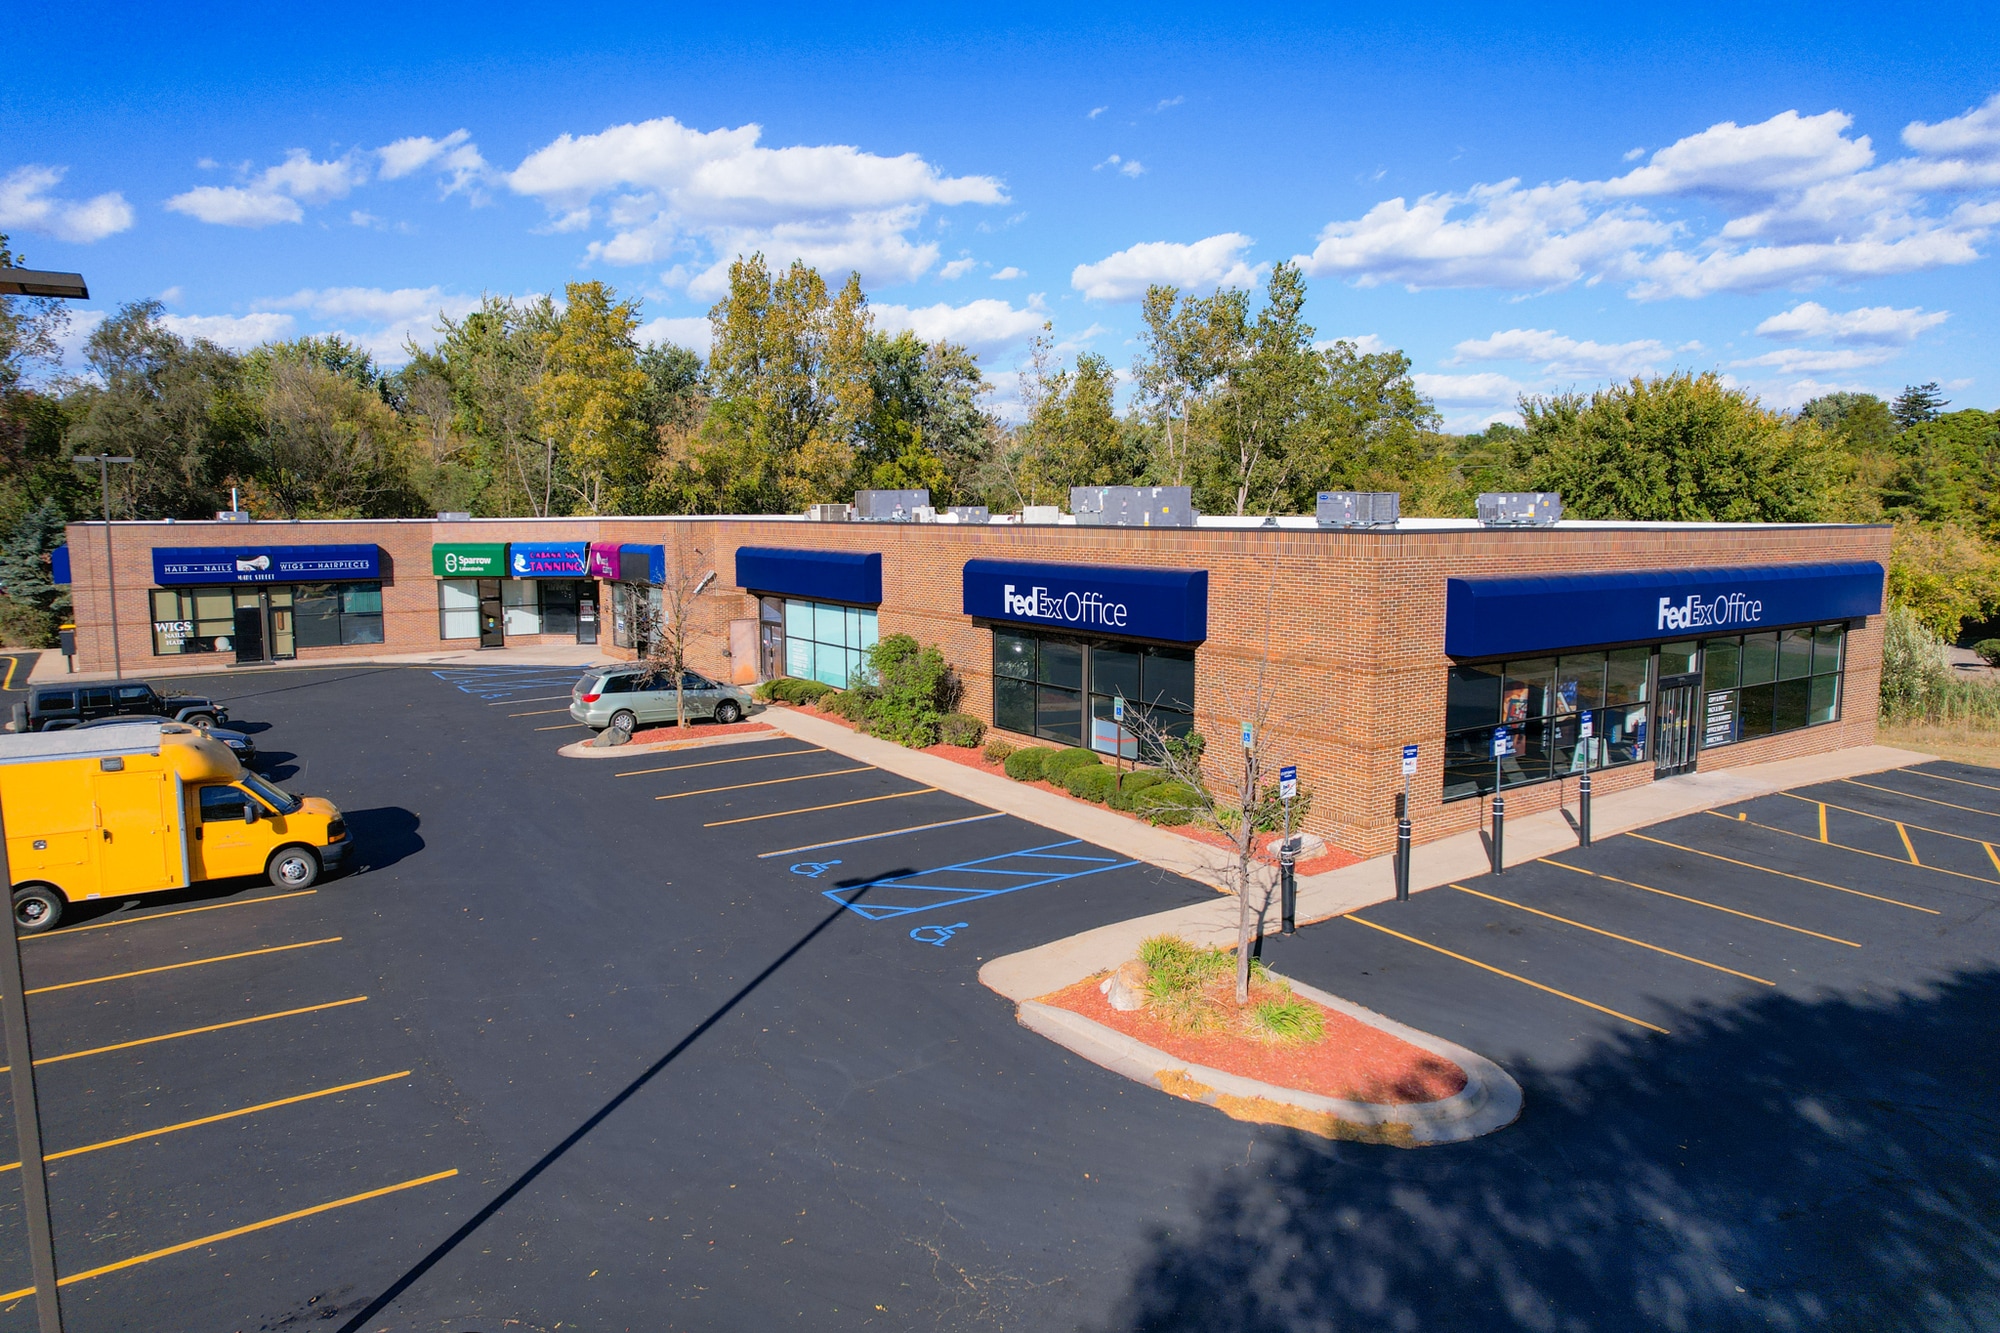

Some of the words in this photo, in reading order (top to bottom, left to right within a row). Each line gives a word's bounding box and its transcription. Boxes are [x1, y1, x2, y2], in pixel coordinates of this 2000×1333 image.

[280, 562, 304, 570] WIGS
[318, 560, 370, 569] HAIRPIECES
[458, 556, 491, 567] Sparrow
[529, 561, 583, 572] TANNING
[154, 621, 192, 632] WIGS
